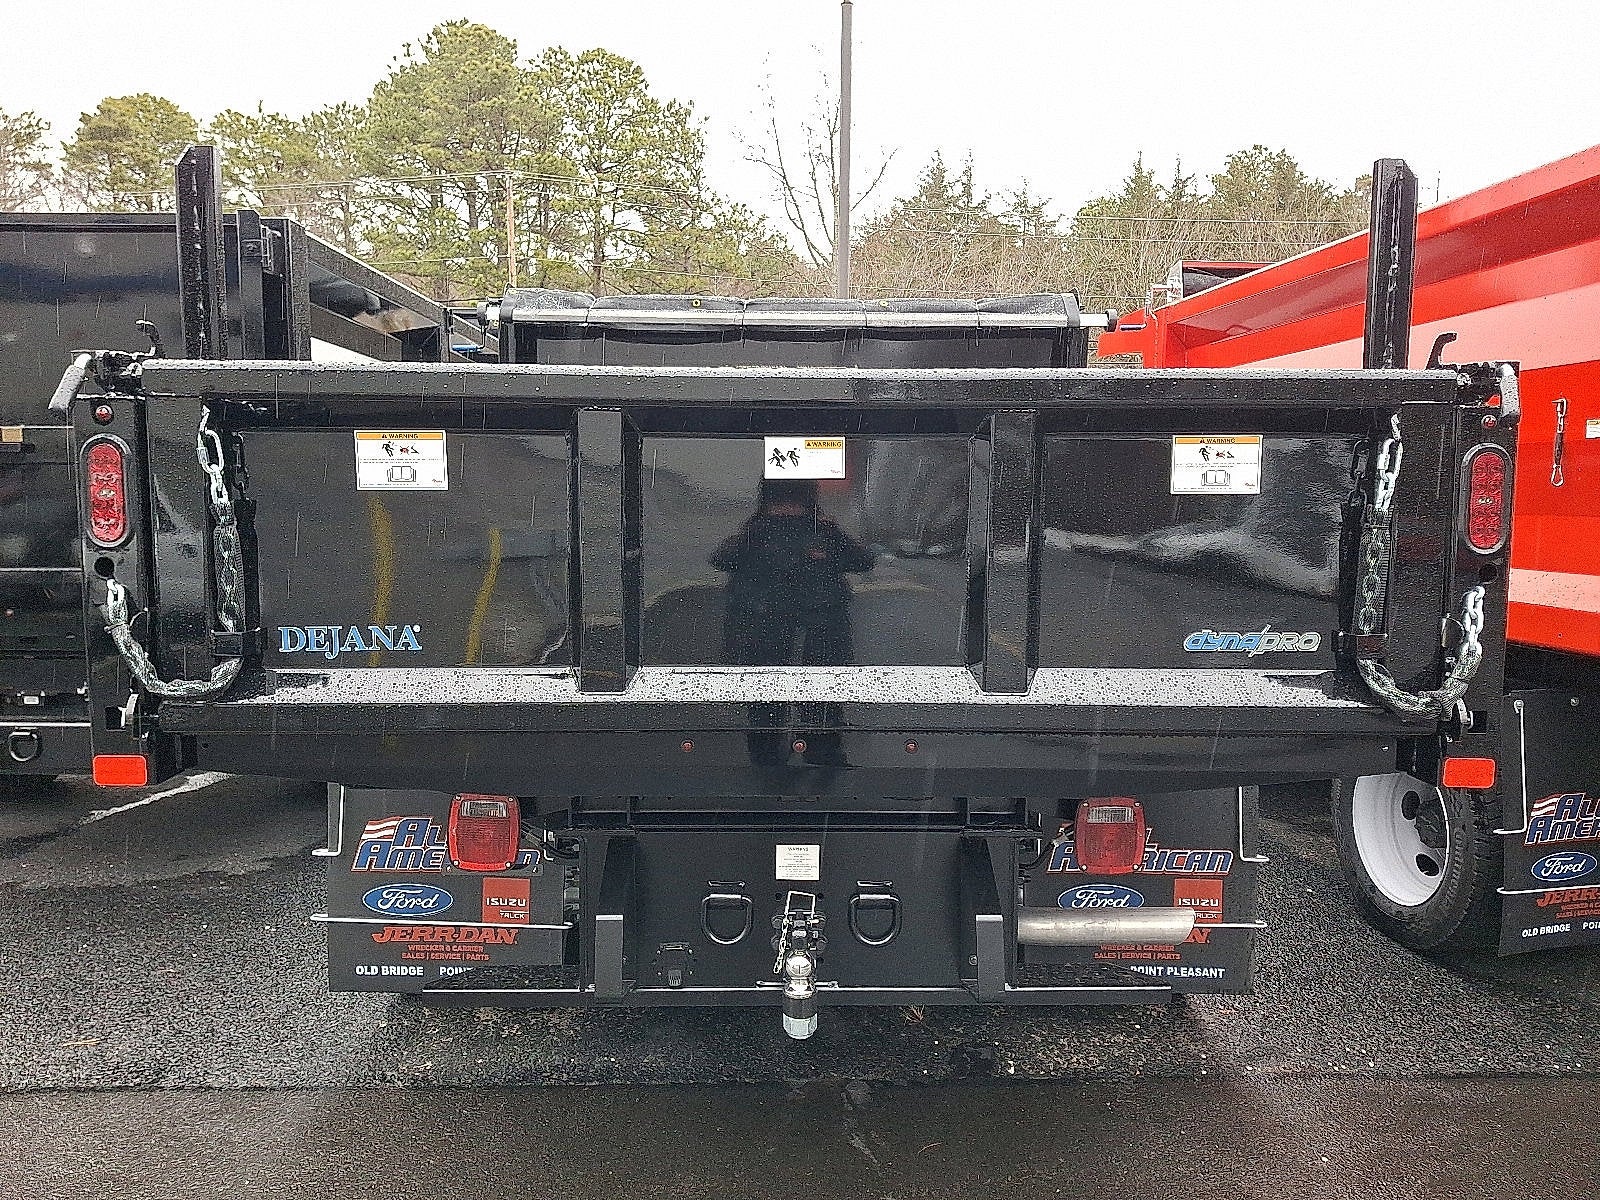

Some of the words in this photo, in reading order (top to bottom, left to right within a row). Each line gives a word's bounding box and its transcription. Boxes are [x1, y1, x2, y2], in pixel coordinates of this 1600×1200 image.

[393, 816, 448, 850] AL
[1541, 856, 1587, 877] Ford
[377, 888, 440, 910] Ford
[486, 897, 526, 907] ISUZU
[1071, 890, 1131, 908] Ford
[1178, 897, 1219, 907] ISUZU
[499, 912, 525, 920] TRUCK
[371, 925, 519, 945] JERR-DAN
[1521, 927, 1539, 938] OLD
[1540, 923, 1571, 935] BRIDGE
[408, 944, 445, 952] WRECKER
[452, 945, 484, 953] CARRIER
[430, 952, 461, 960] SERVICE
[466, 953, 490, 961] PARTS
[355, 965, 379, 976] OLD
[381, 965, 424, 977] BRIDGE
[1167, 966, 1226, 979] PLEASANT
